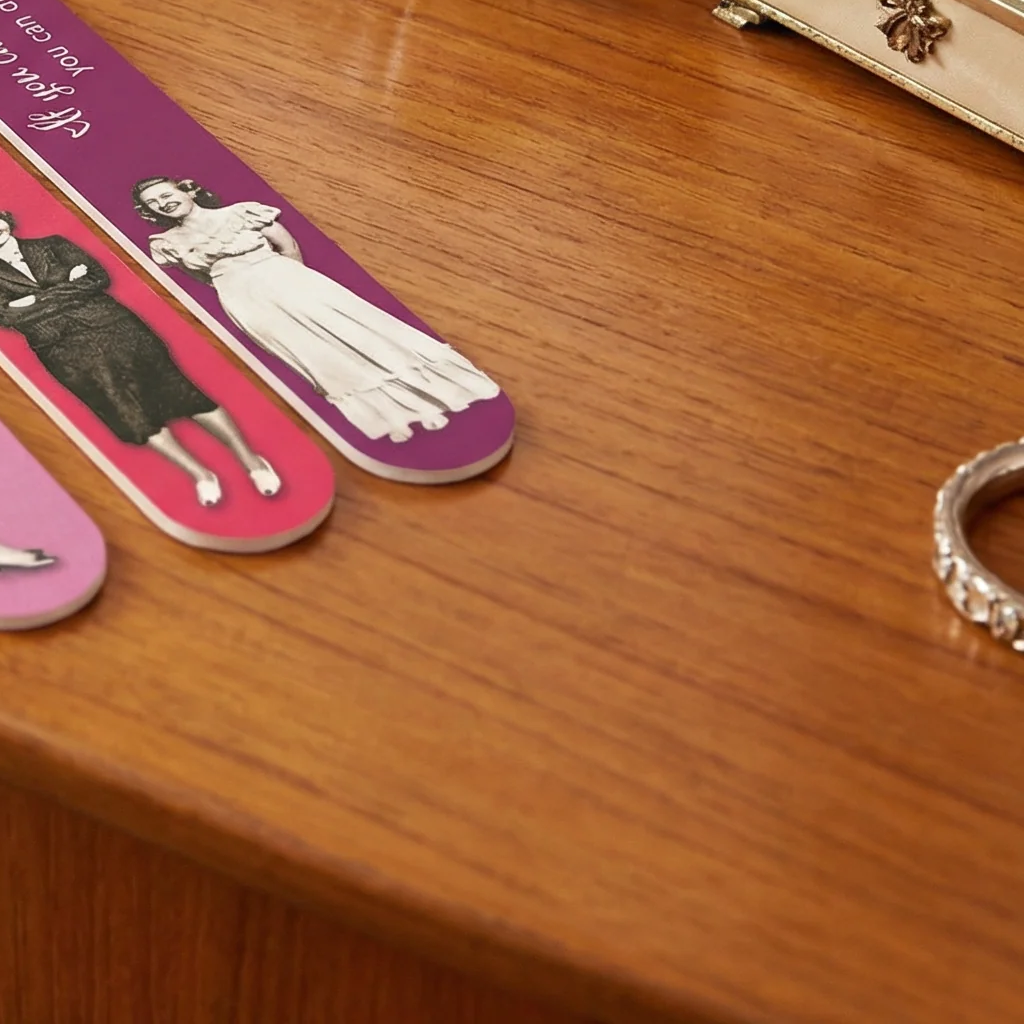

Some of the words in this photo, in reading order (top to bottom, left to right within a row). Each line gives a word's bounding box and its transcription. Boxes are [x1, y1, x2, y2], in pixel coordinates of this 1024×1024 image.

[15, 15, 52, 42] can
[47, 46, 94, 77] you
[12, 67, 75, 102] you
[27, 107, 90, 139] If
